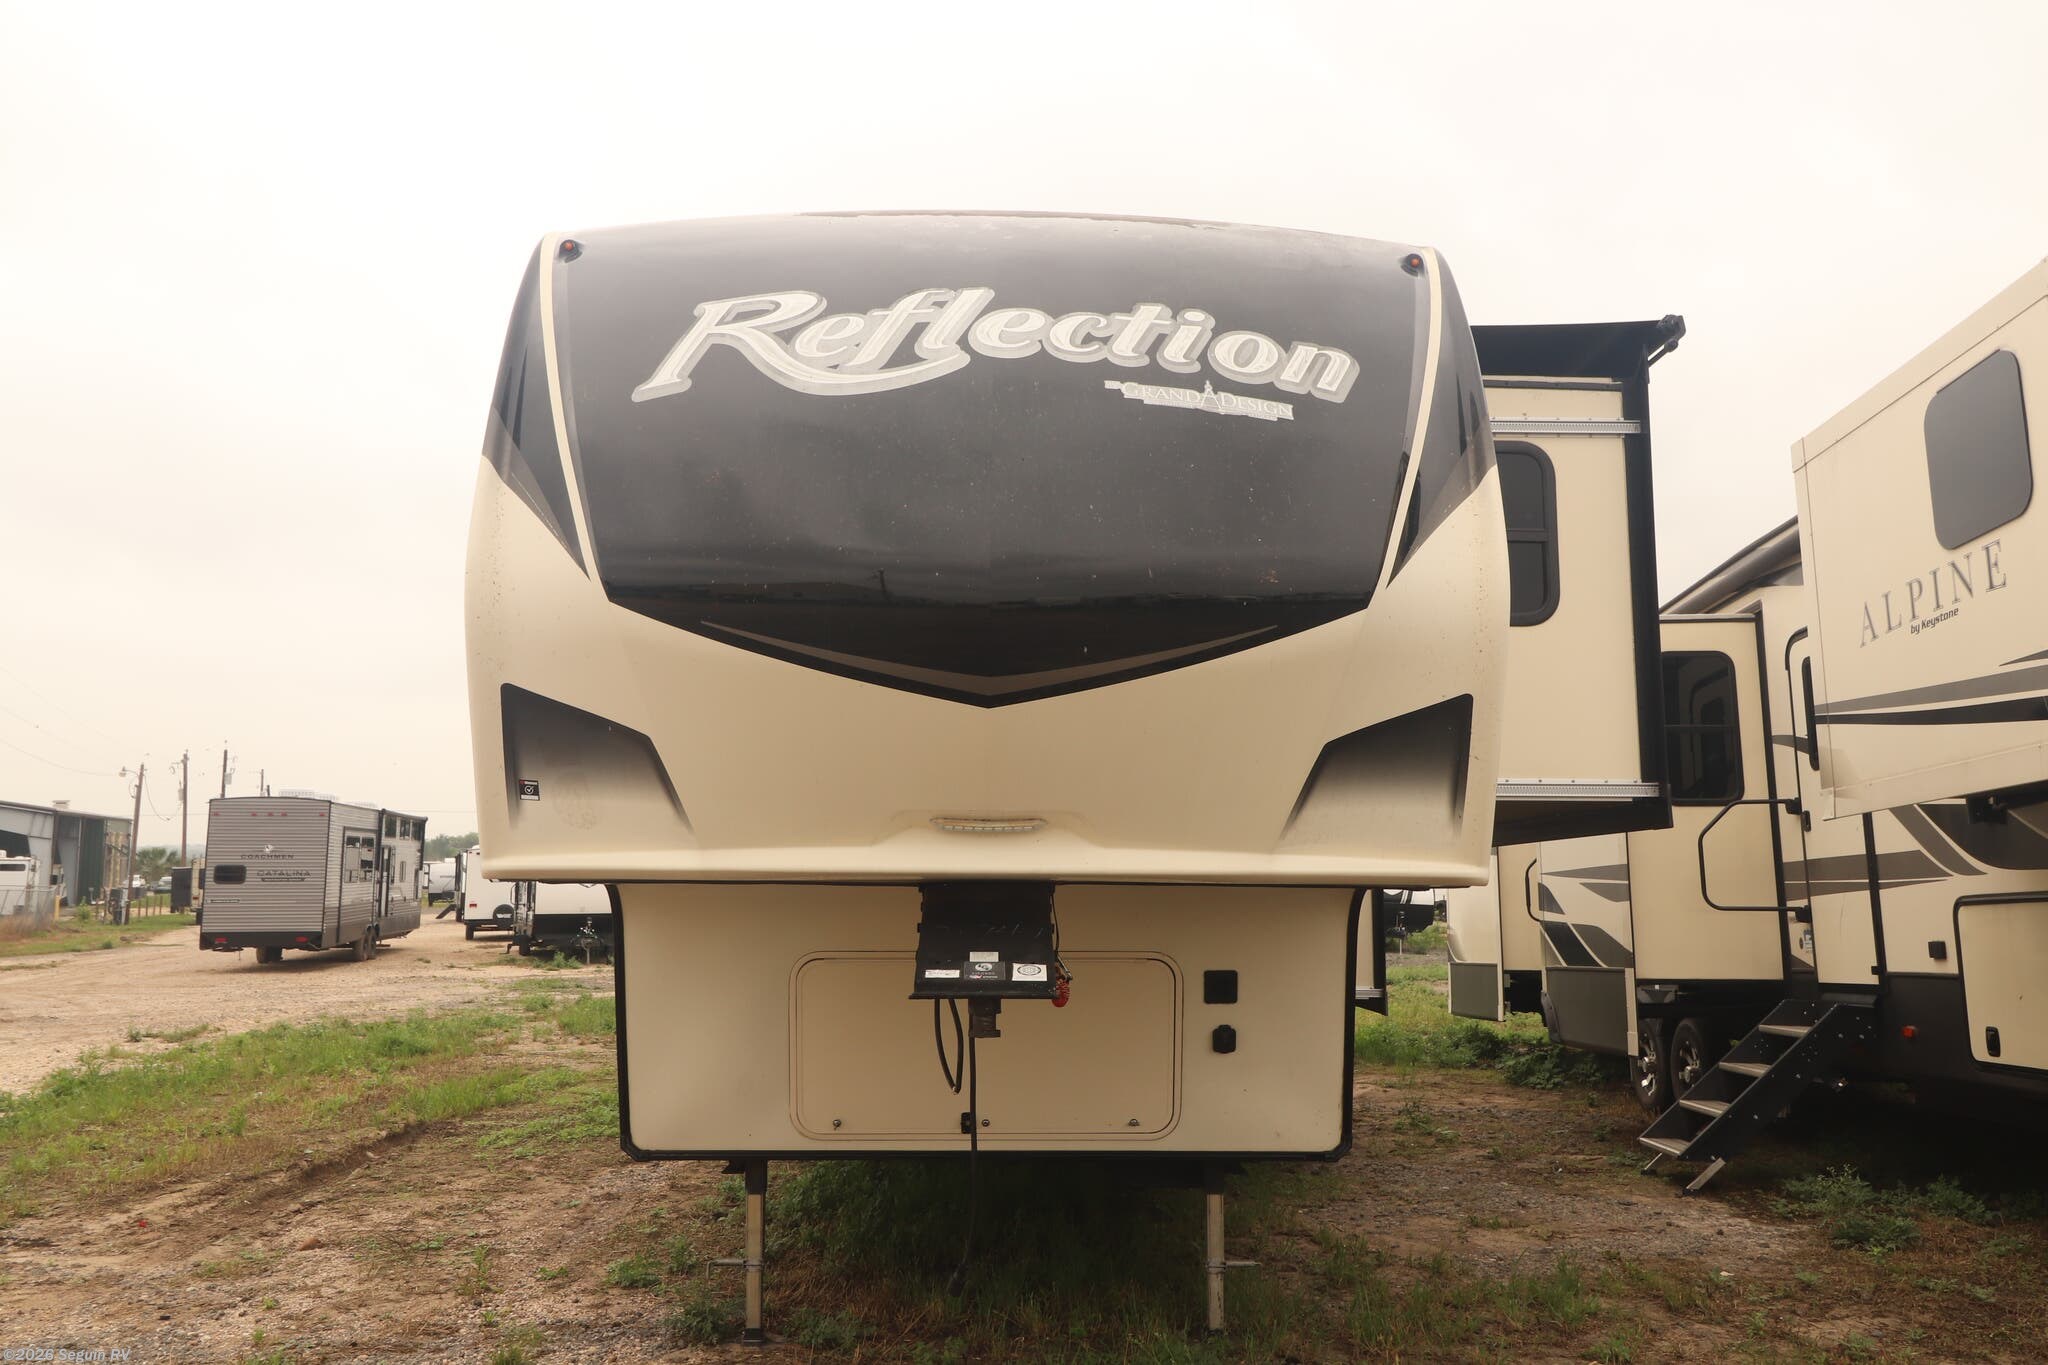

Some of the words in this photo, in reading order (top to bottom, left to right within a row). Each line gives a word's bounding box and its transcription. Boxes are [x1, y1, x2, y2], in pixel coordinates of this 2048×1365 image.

[631, 287, 1360, 402] Reflection
[1859, 539, 2007, 648] ALPINE
[1910, 624, 1920, 635] by
[1921, 608, 1959, 629] Keystone
[256, 869, 311, 877] CATALINA
